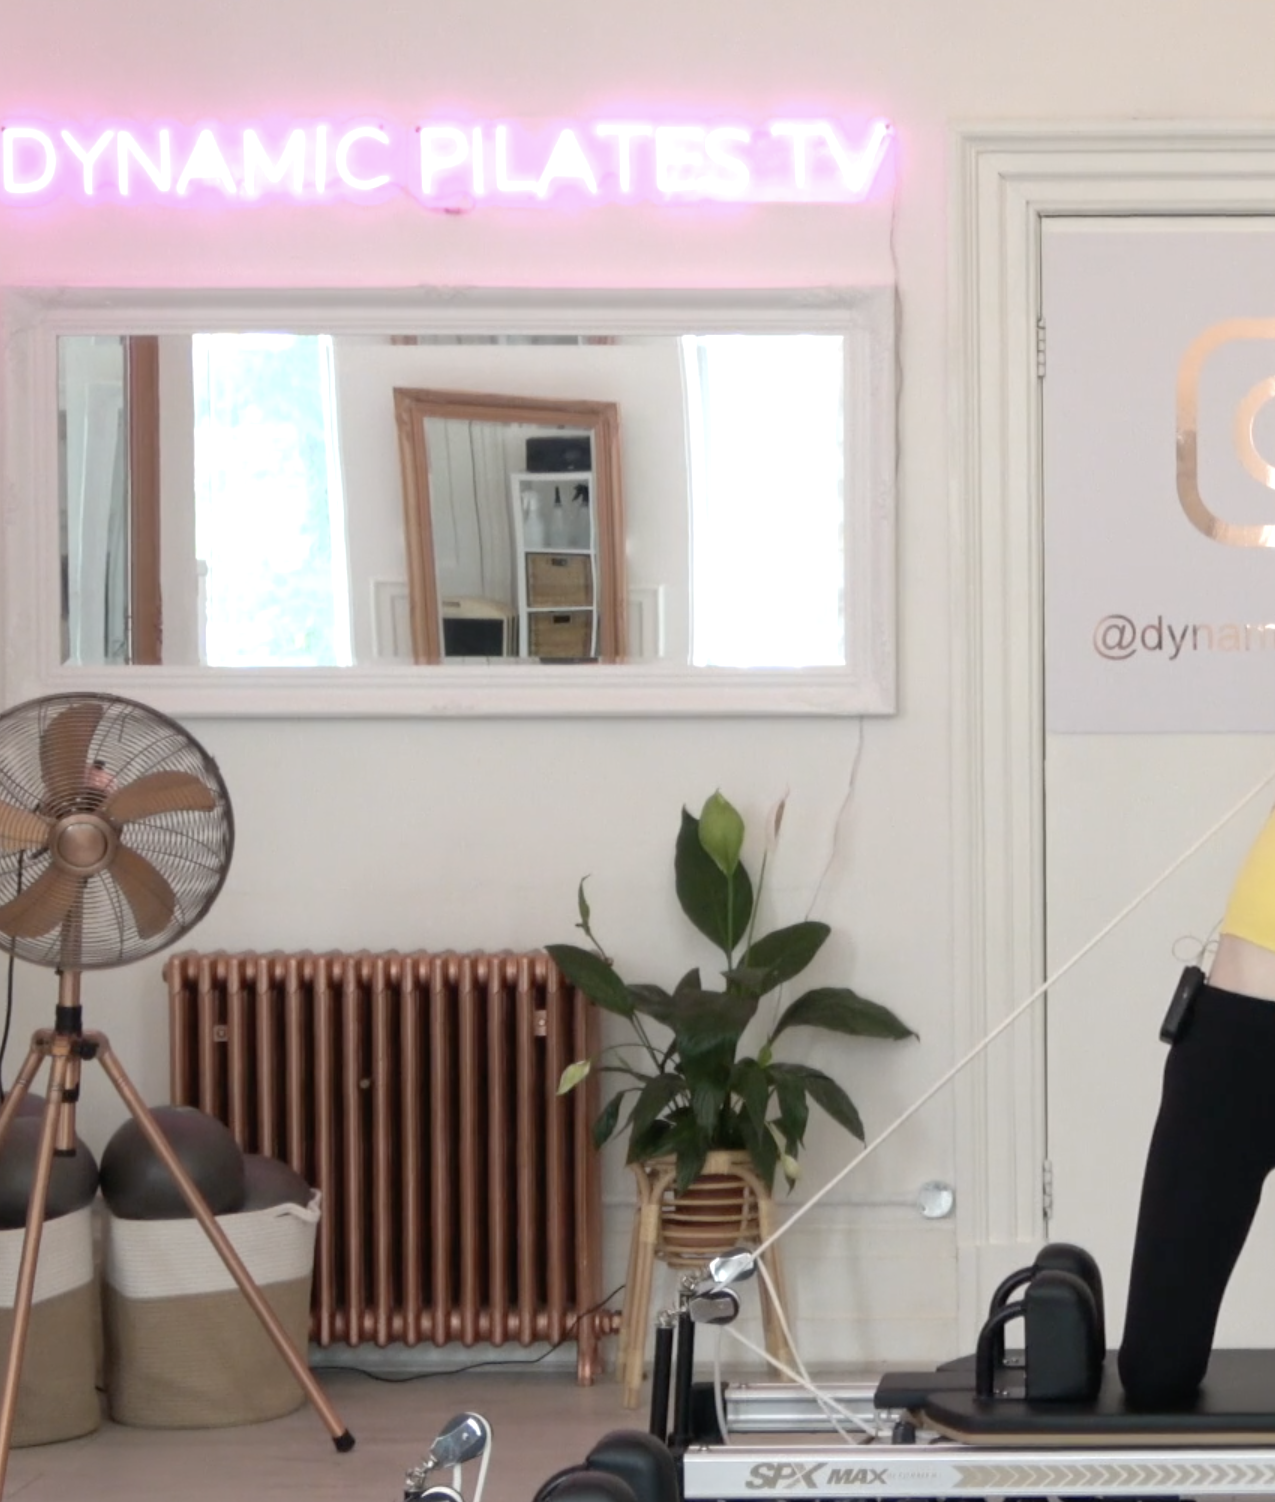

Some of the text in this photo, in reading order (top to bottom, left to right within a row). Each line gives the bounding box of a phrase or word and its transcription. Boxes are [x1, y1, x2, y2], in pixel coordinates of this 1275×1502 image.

[2, 121, 893, 198] DYNAMIC PILATES TV
[745, 1461, 889, 1489] SPX MAX
